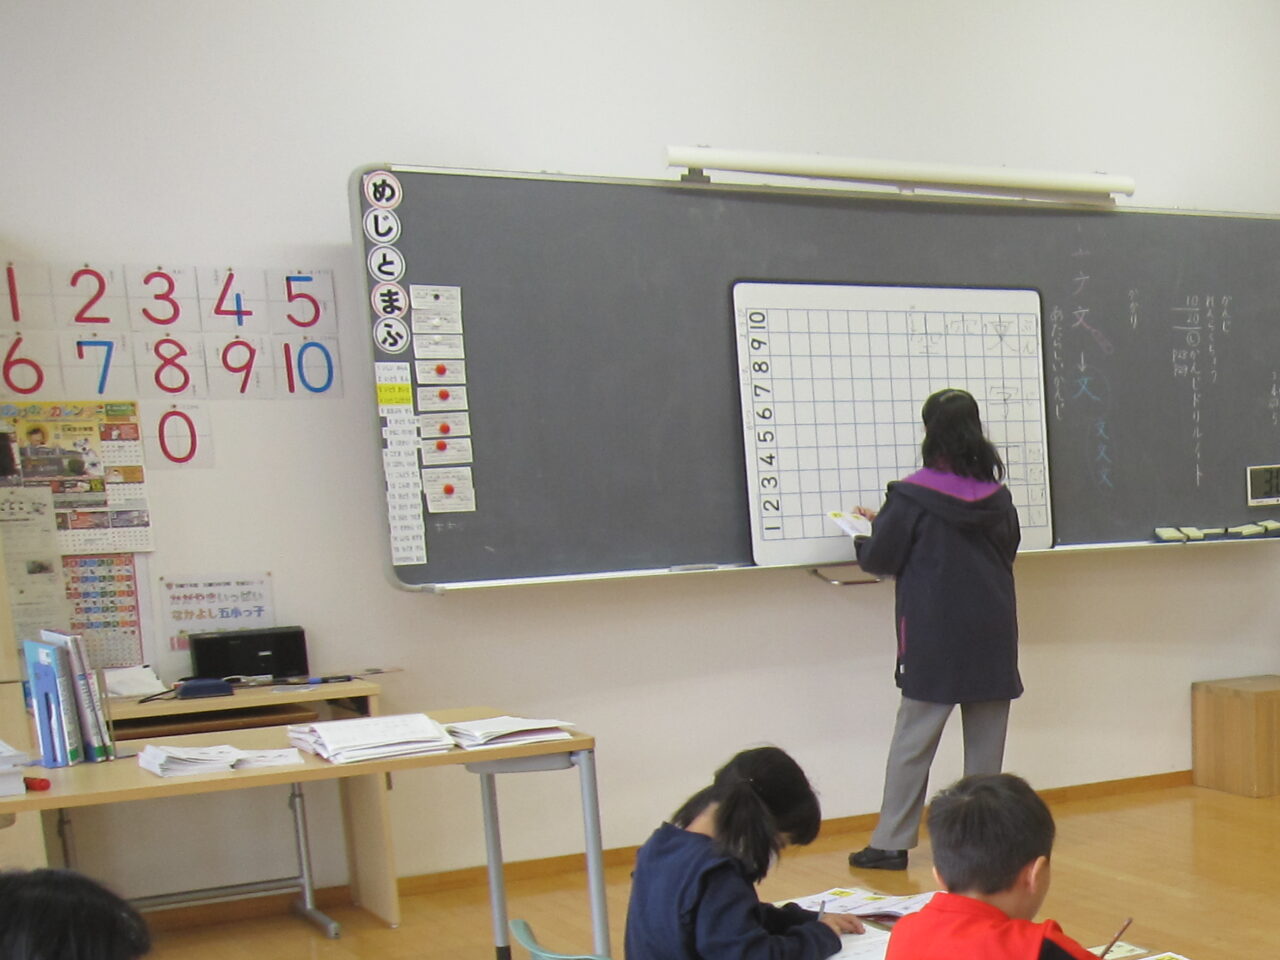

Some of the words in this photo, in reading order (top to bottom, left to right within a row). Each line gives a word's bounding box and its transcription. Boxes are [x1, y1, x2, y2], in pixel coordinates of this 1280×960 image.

[6, 266, 20, 322] 1
[70, 268, 111, 324] 2
[142, 270, 181, 326] 3
[214, 272, 253, 327] 4
[285, 275, 322, 328] 5
[748, 311, 767, 330] 10
[750, 337, 767, 351] 9
[3, 336, 45, 395] 6
[77, 340, 114, 395] 7
[154, 338, 191, 394] 8
[222, 340, 257, 395] 9
[284, 341, 334, 394] 10
[752, 360, 770, 374] 8
[753, 383, 771, 397] 7
[755, 408, 773, 420] 6
[158, 410, 198, 464] 0
[757, 430, 775, 443] 5
[759, 452, 776, 466] 4
[761, 476, 778, 489] 3
[763, 498, 780, 512] 2
[170, 604, 266, 622] なかよし五小っ子
